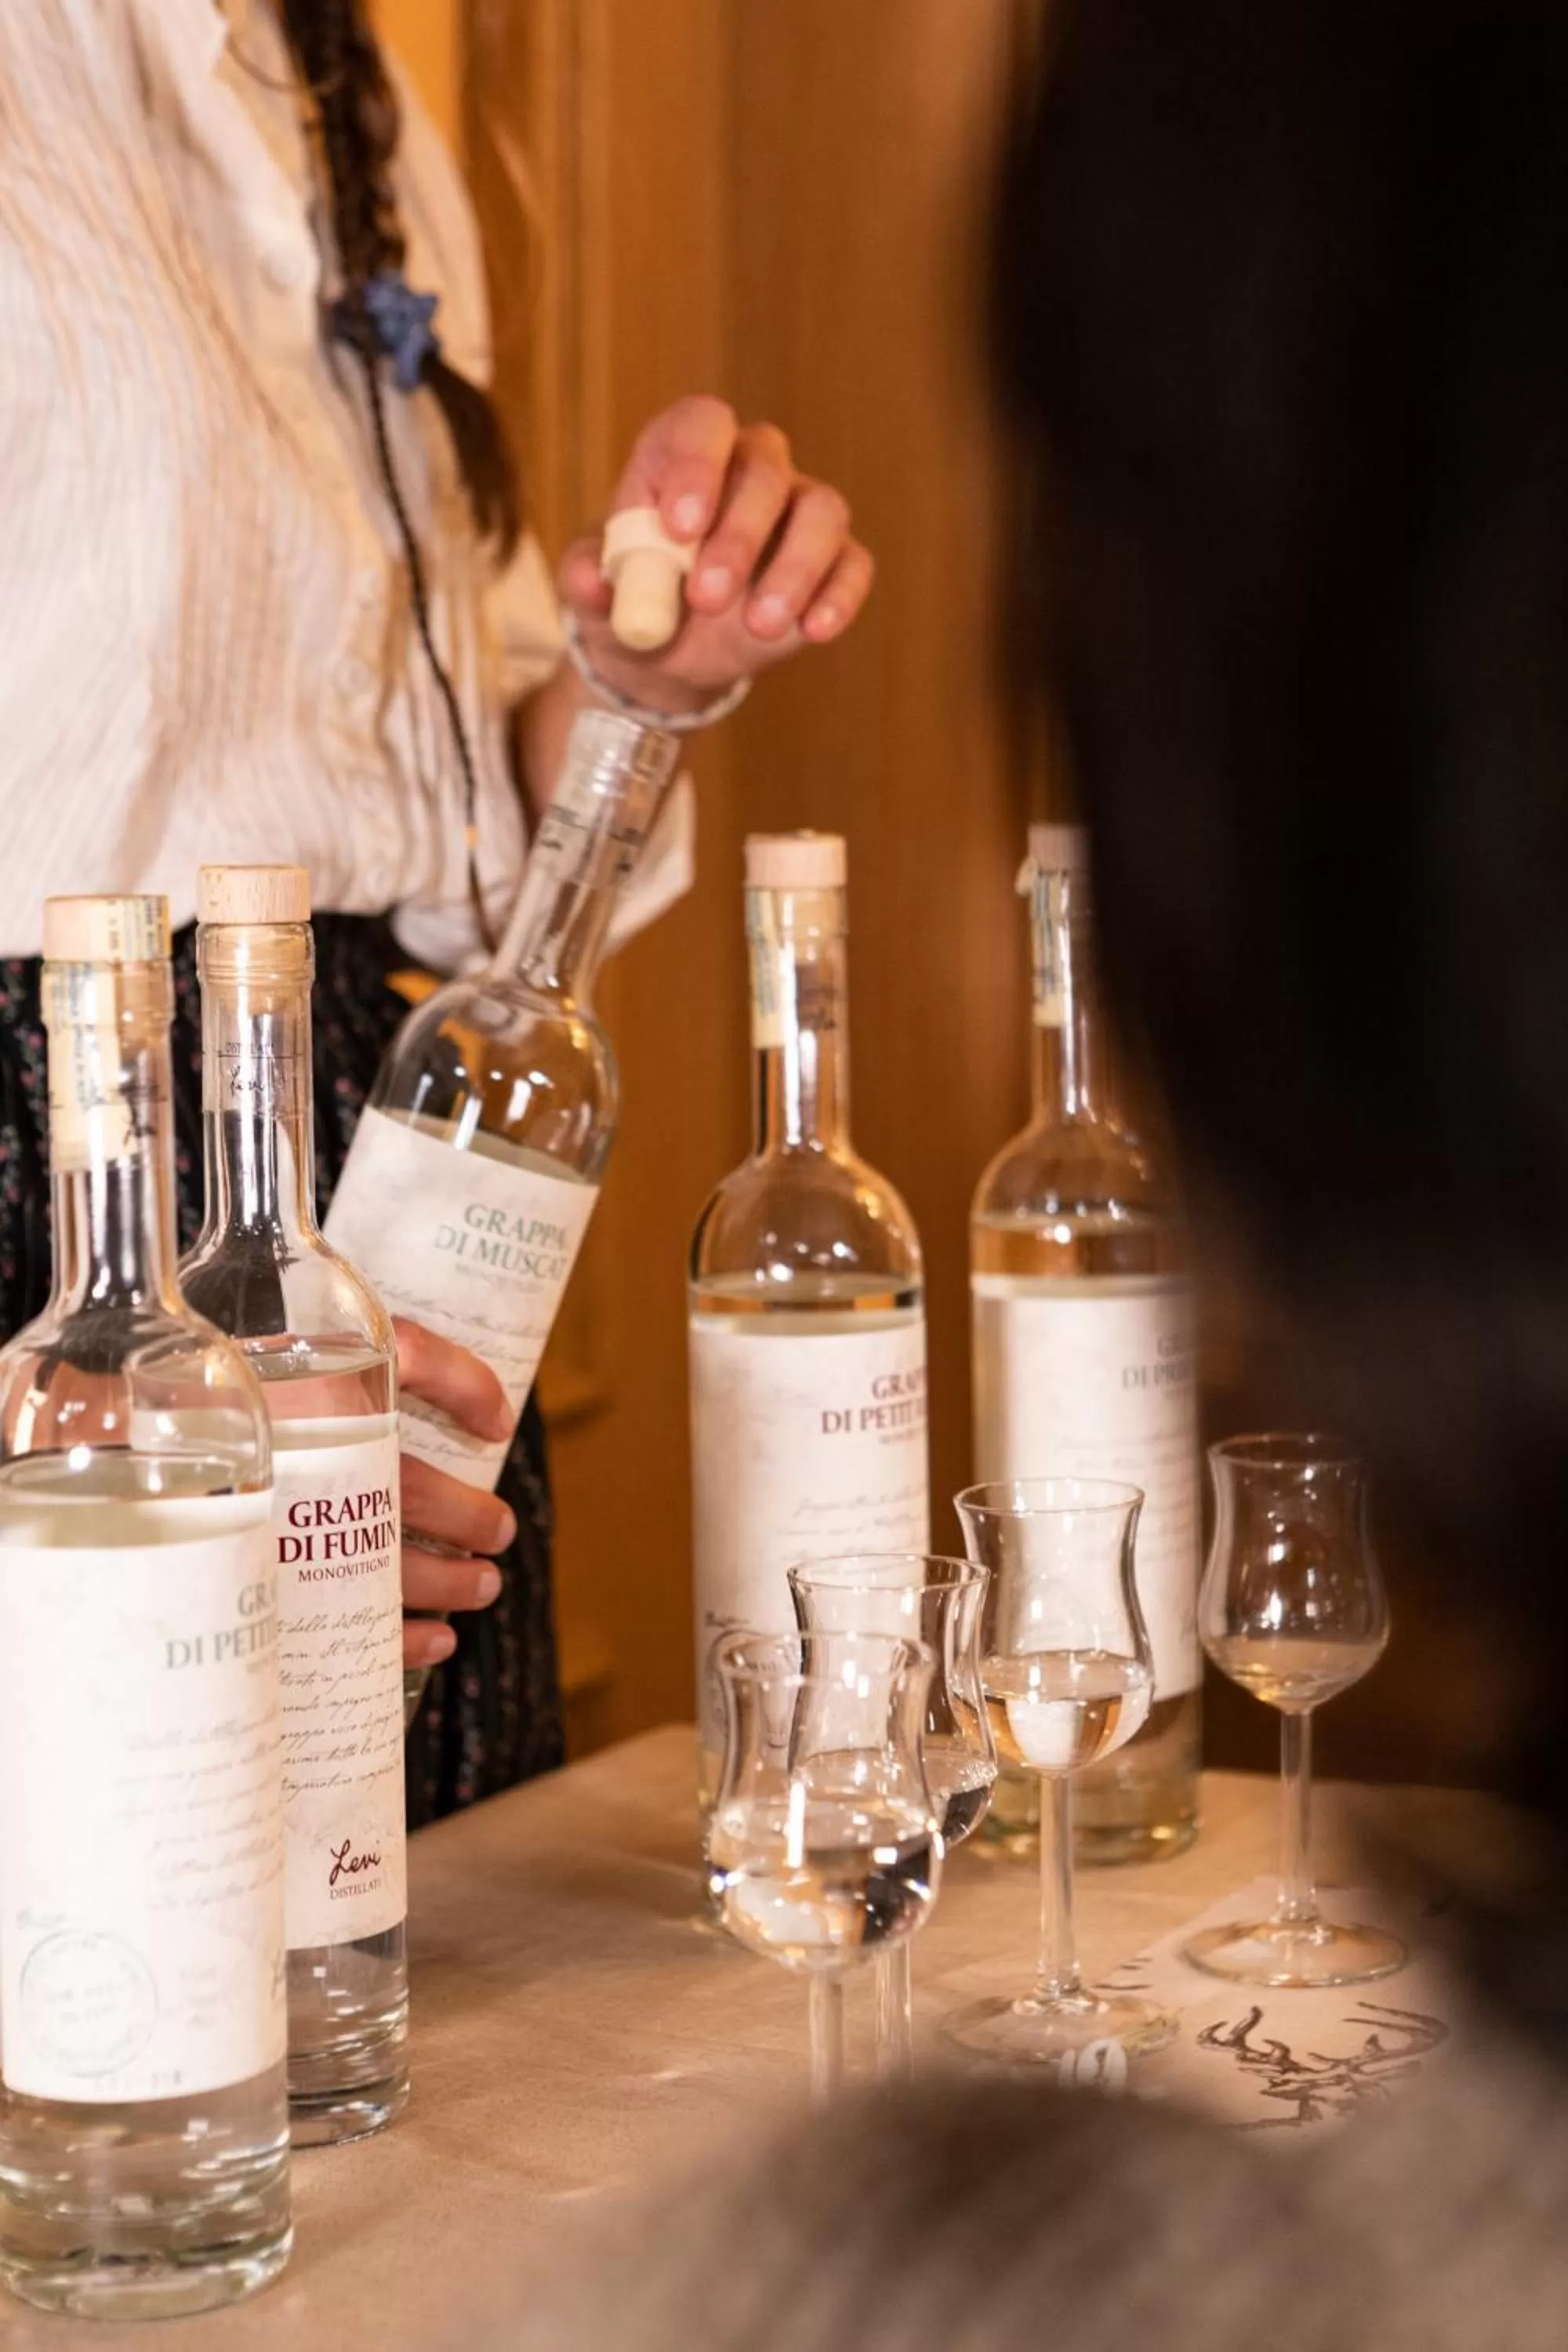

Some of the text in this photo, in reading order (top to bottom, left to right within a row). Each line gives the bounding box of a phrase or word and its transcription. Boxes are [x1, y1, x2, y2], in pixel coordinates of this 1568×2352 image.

[434, 1224, 469, 1255] DI
[821, 1409, 851, 1435] DI
[288, 1487, 392, 1528] GRAPPA
[278, 1518, 396, 1563] DI FUMIN
[298, 1555, 390, 1583] MONOVITIGNO
[165, 1635, 202, 1669] DI
[328, 1838, 381, 1886] Levi
